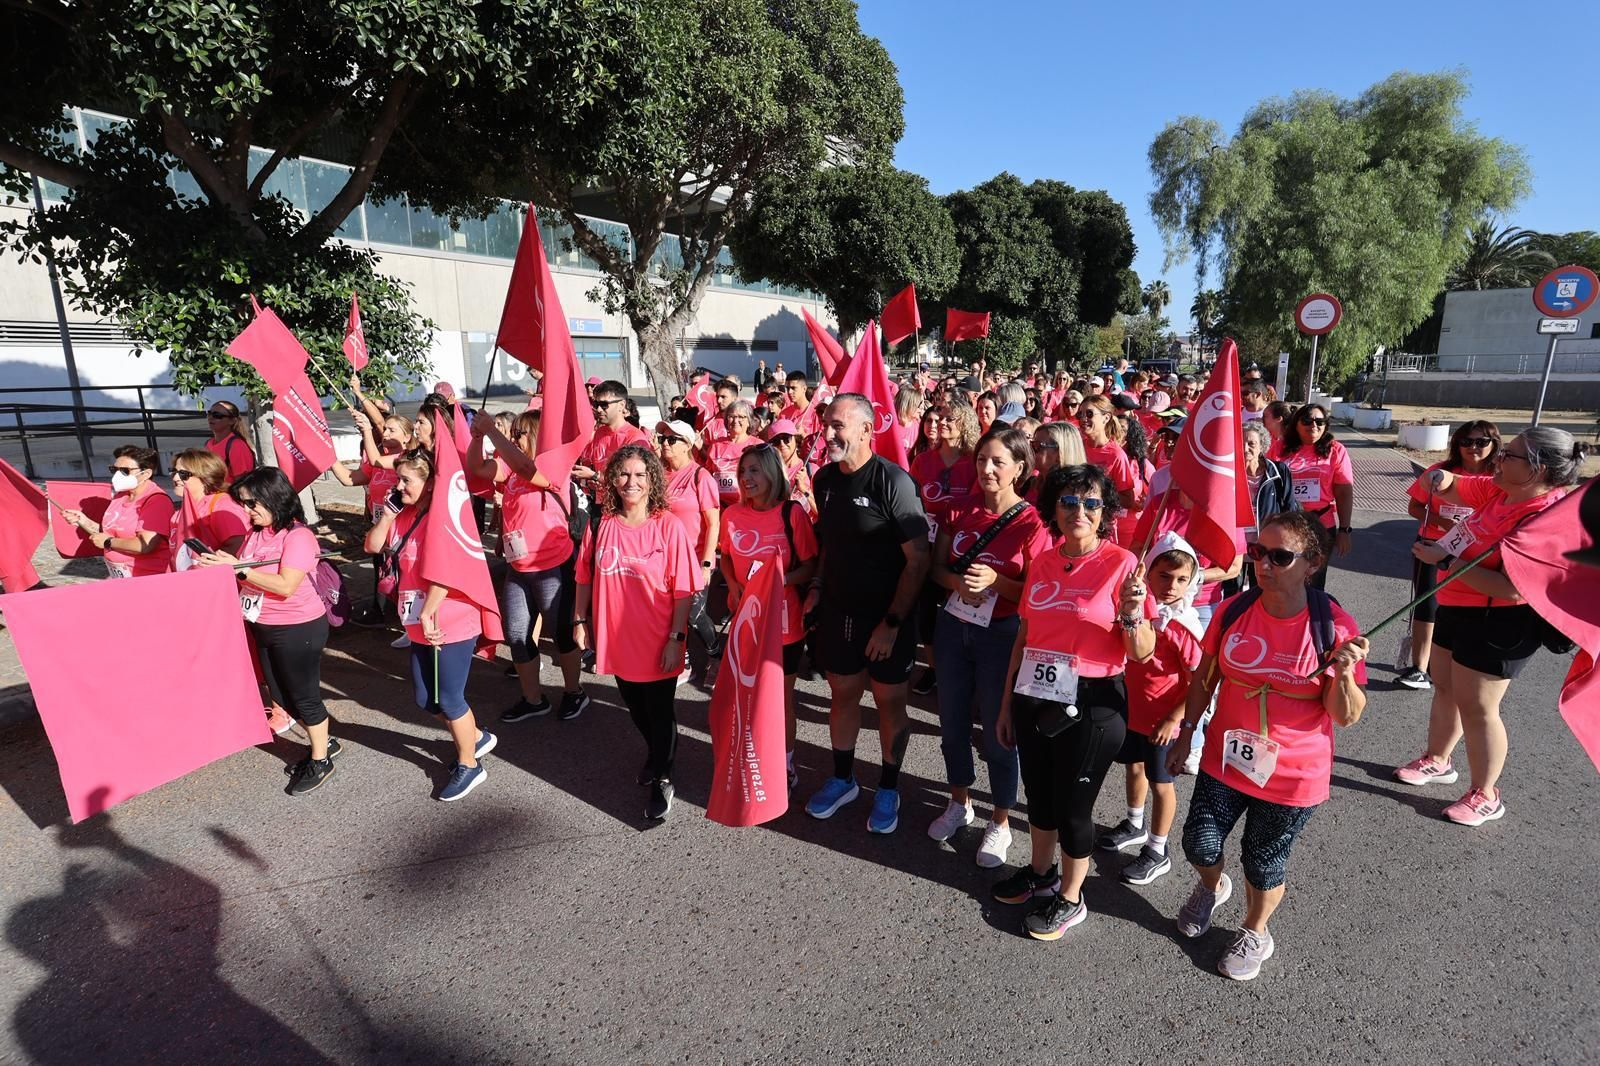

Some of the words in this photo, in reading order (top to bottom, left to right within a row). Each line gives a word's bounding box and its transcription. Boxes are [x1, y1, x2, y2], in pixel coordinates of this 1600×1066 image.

[575, 320, 585, 331] 15
[485, 342, 527, 382] 15
[272, 424, 285, 441] MA
[284, 441, 306, 463] JEREZ
[1294, 485, 1308, 495] 52
[1450, 533, 1462, 550] 22
[1034, 663, 1057, 683] 56
[1229, 739, 1253, 761] 18
